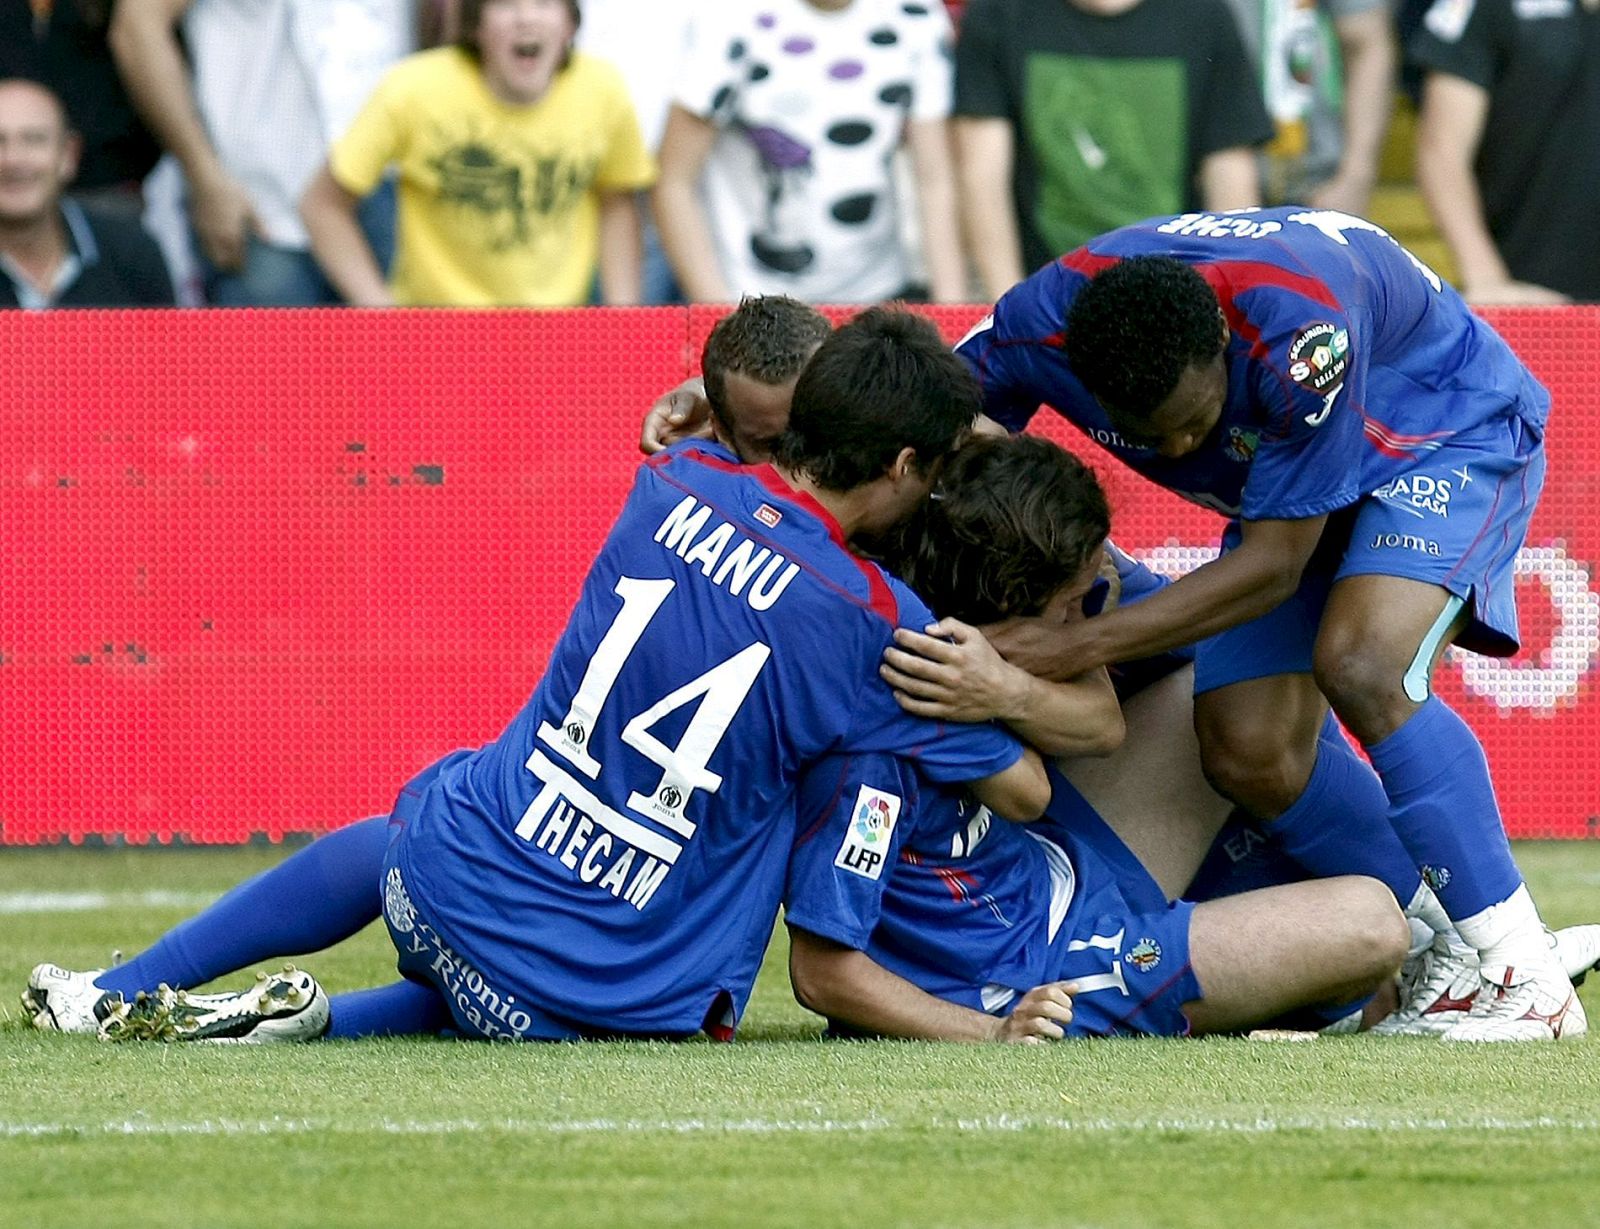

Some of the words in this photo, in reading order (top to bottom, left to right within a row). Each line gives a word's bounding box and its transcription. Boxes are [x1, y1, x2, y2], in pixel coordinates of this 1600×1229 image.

[1411, 494, 1449, 518] CASA
[653, 494, 802, 612] MANU
[536, 574, 772, 841] 14
[514, 747, 684, 912] THECAM
[842, 844, 882, 873] LFP
[406, 931, 431, 954] y
